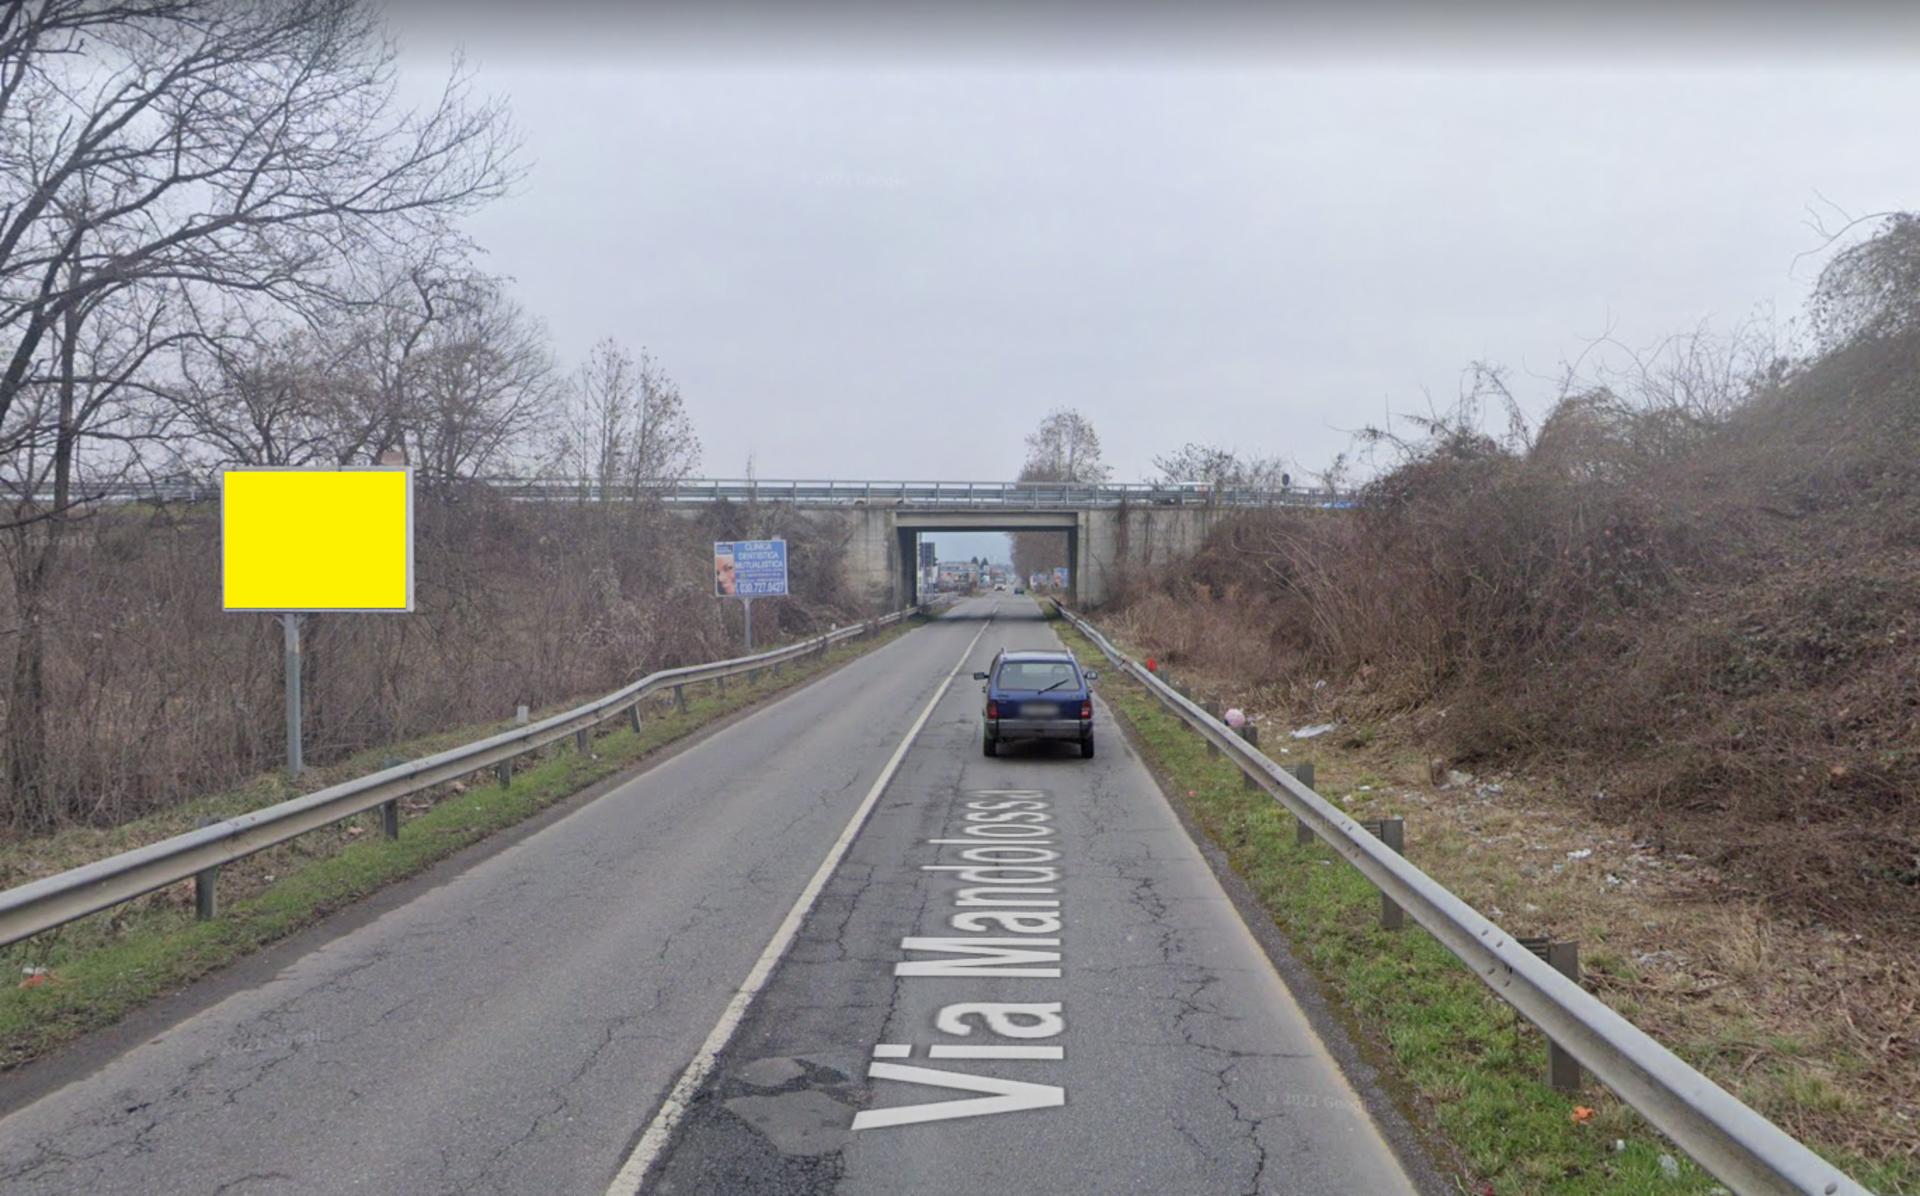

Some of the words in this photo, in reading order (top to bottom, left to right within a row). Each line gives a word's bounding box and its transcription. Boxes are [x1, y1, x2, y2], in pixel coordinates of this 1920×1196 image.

[744, 542, 772, 551] CLINICA
[738, 551, 779, 560] DENTISTICA
[735, 560, 784, 569] MUTUALISTICA
